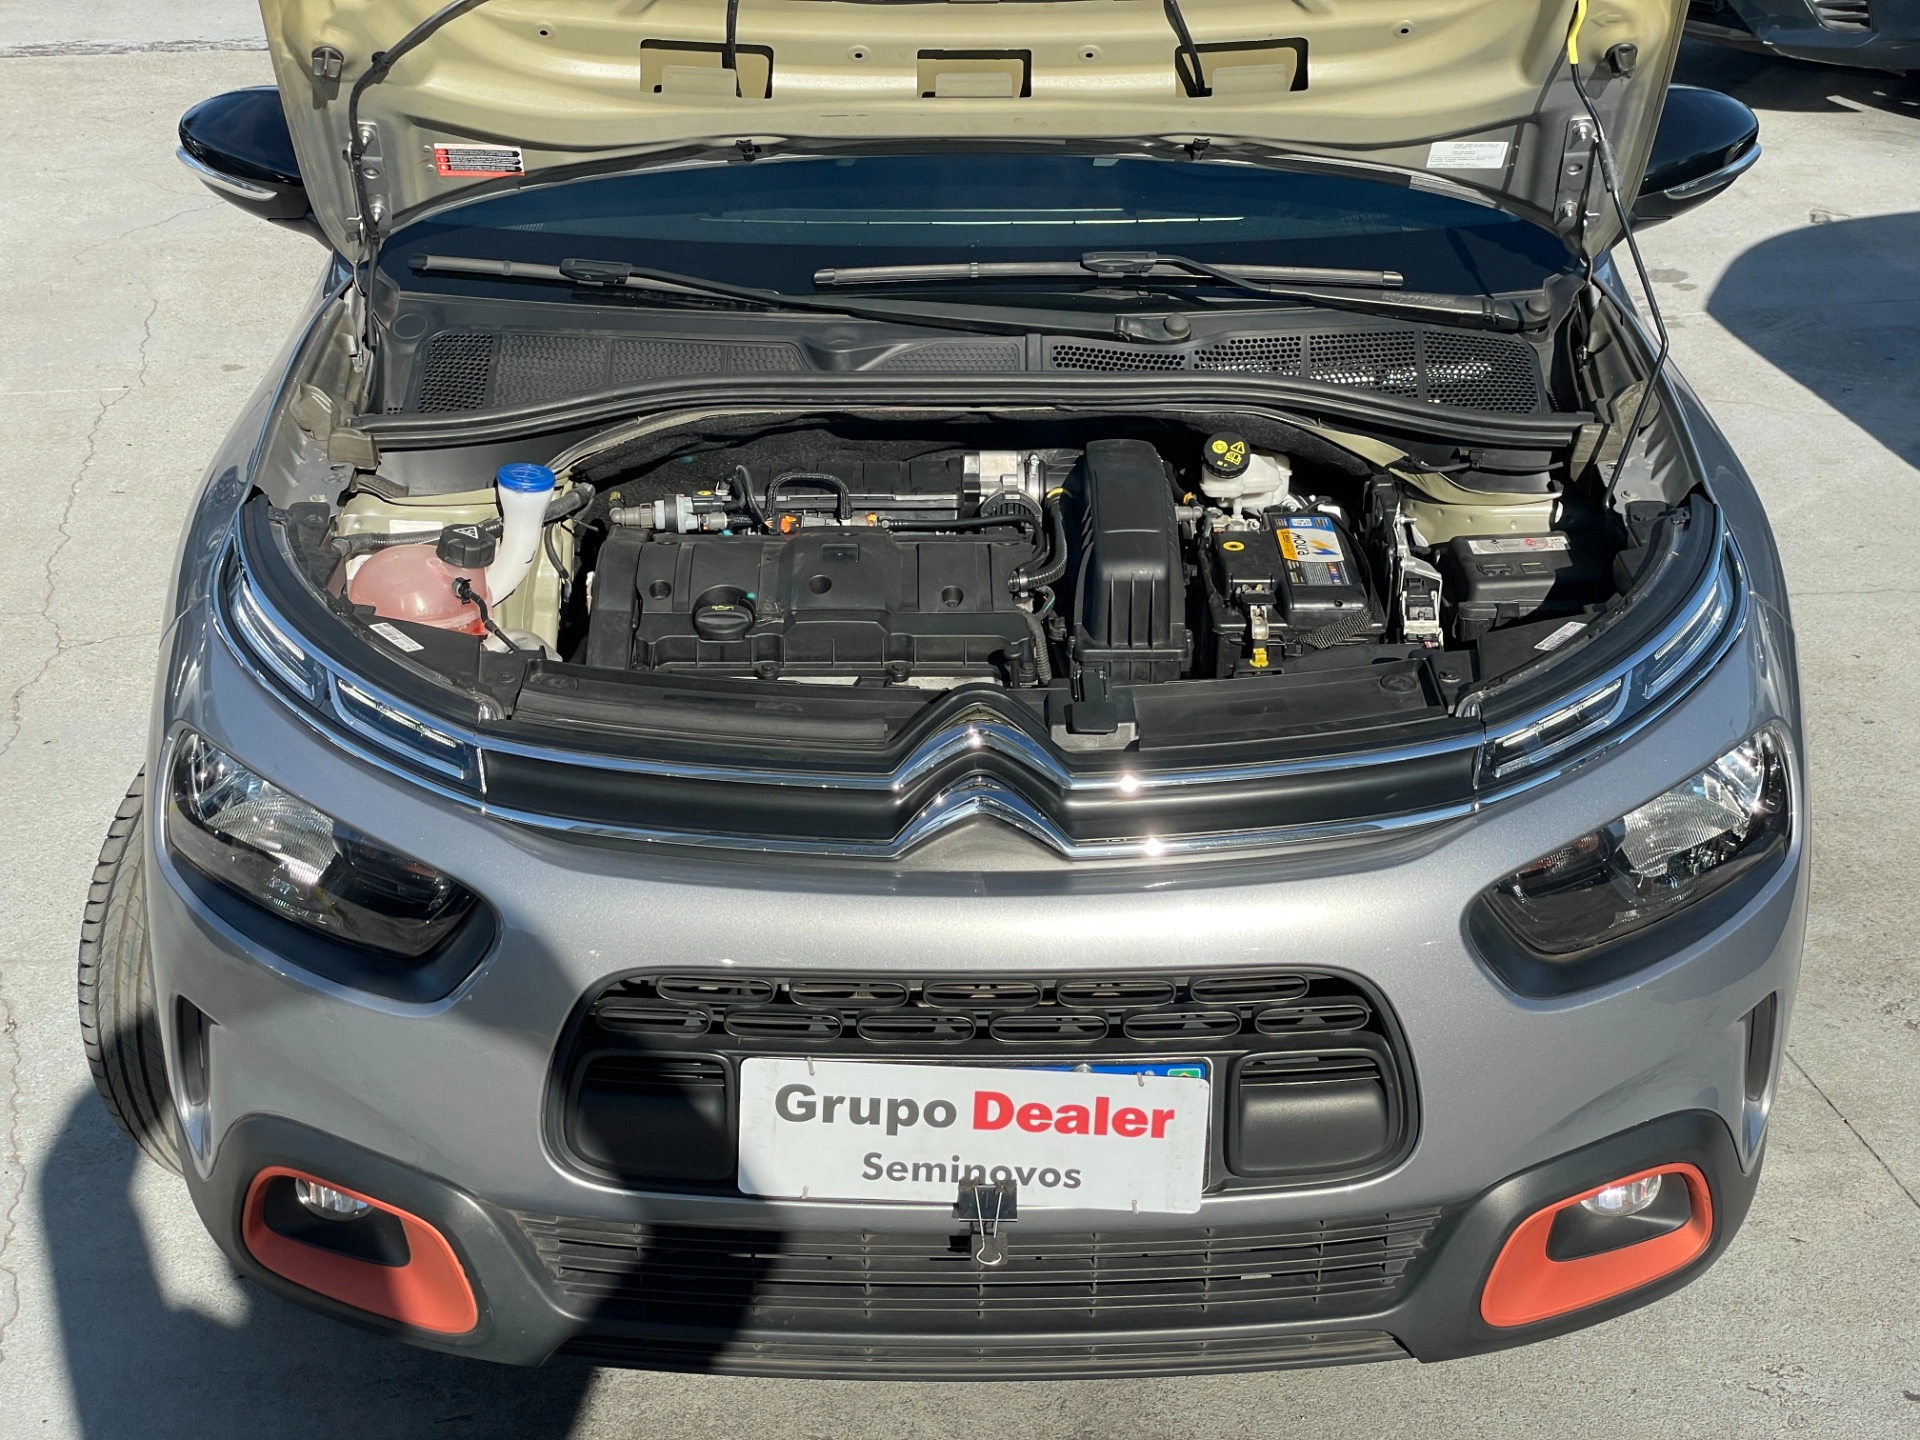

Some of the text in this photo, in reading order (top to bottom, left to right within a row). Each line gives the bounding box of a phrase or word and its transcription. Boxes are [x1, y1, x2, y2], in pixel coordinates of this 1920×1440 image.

[774, 1083, 1175, 1139] Grupo Dealer
[861, 1151, 1082, 1189] Seminovos
